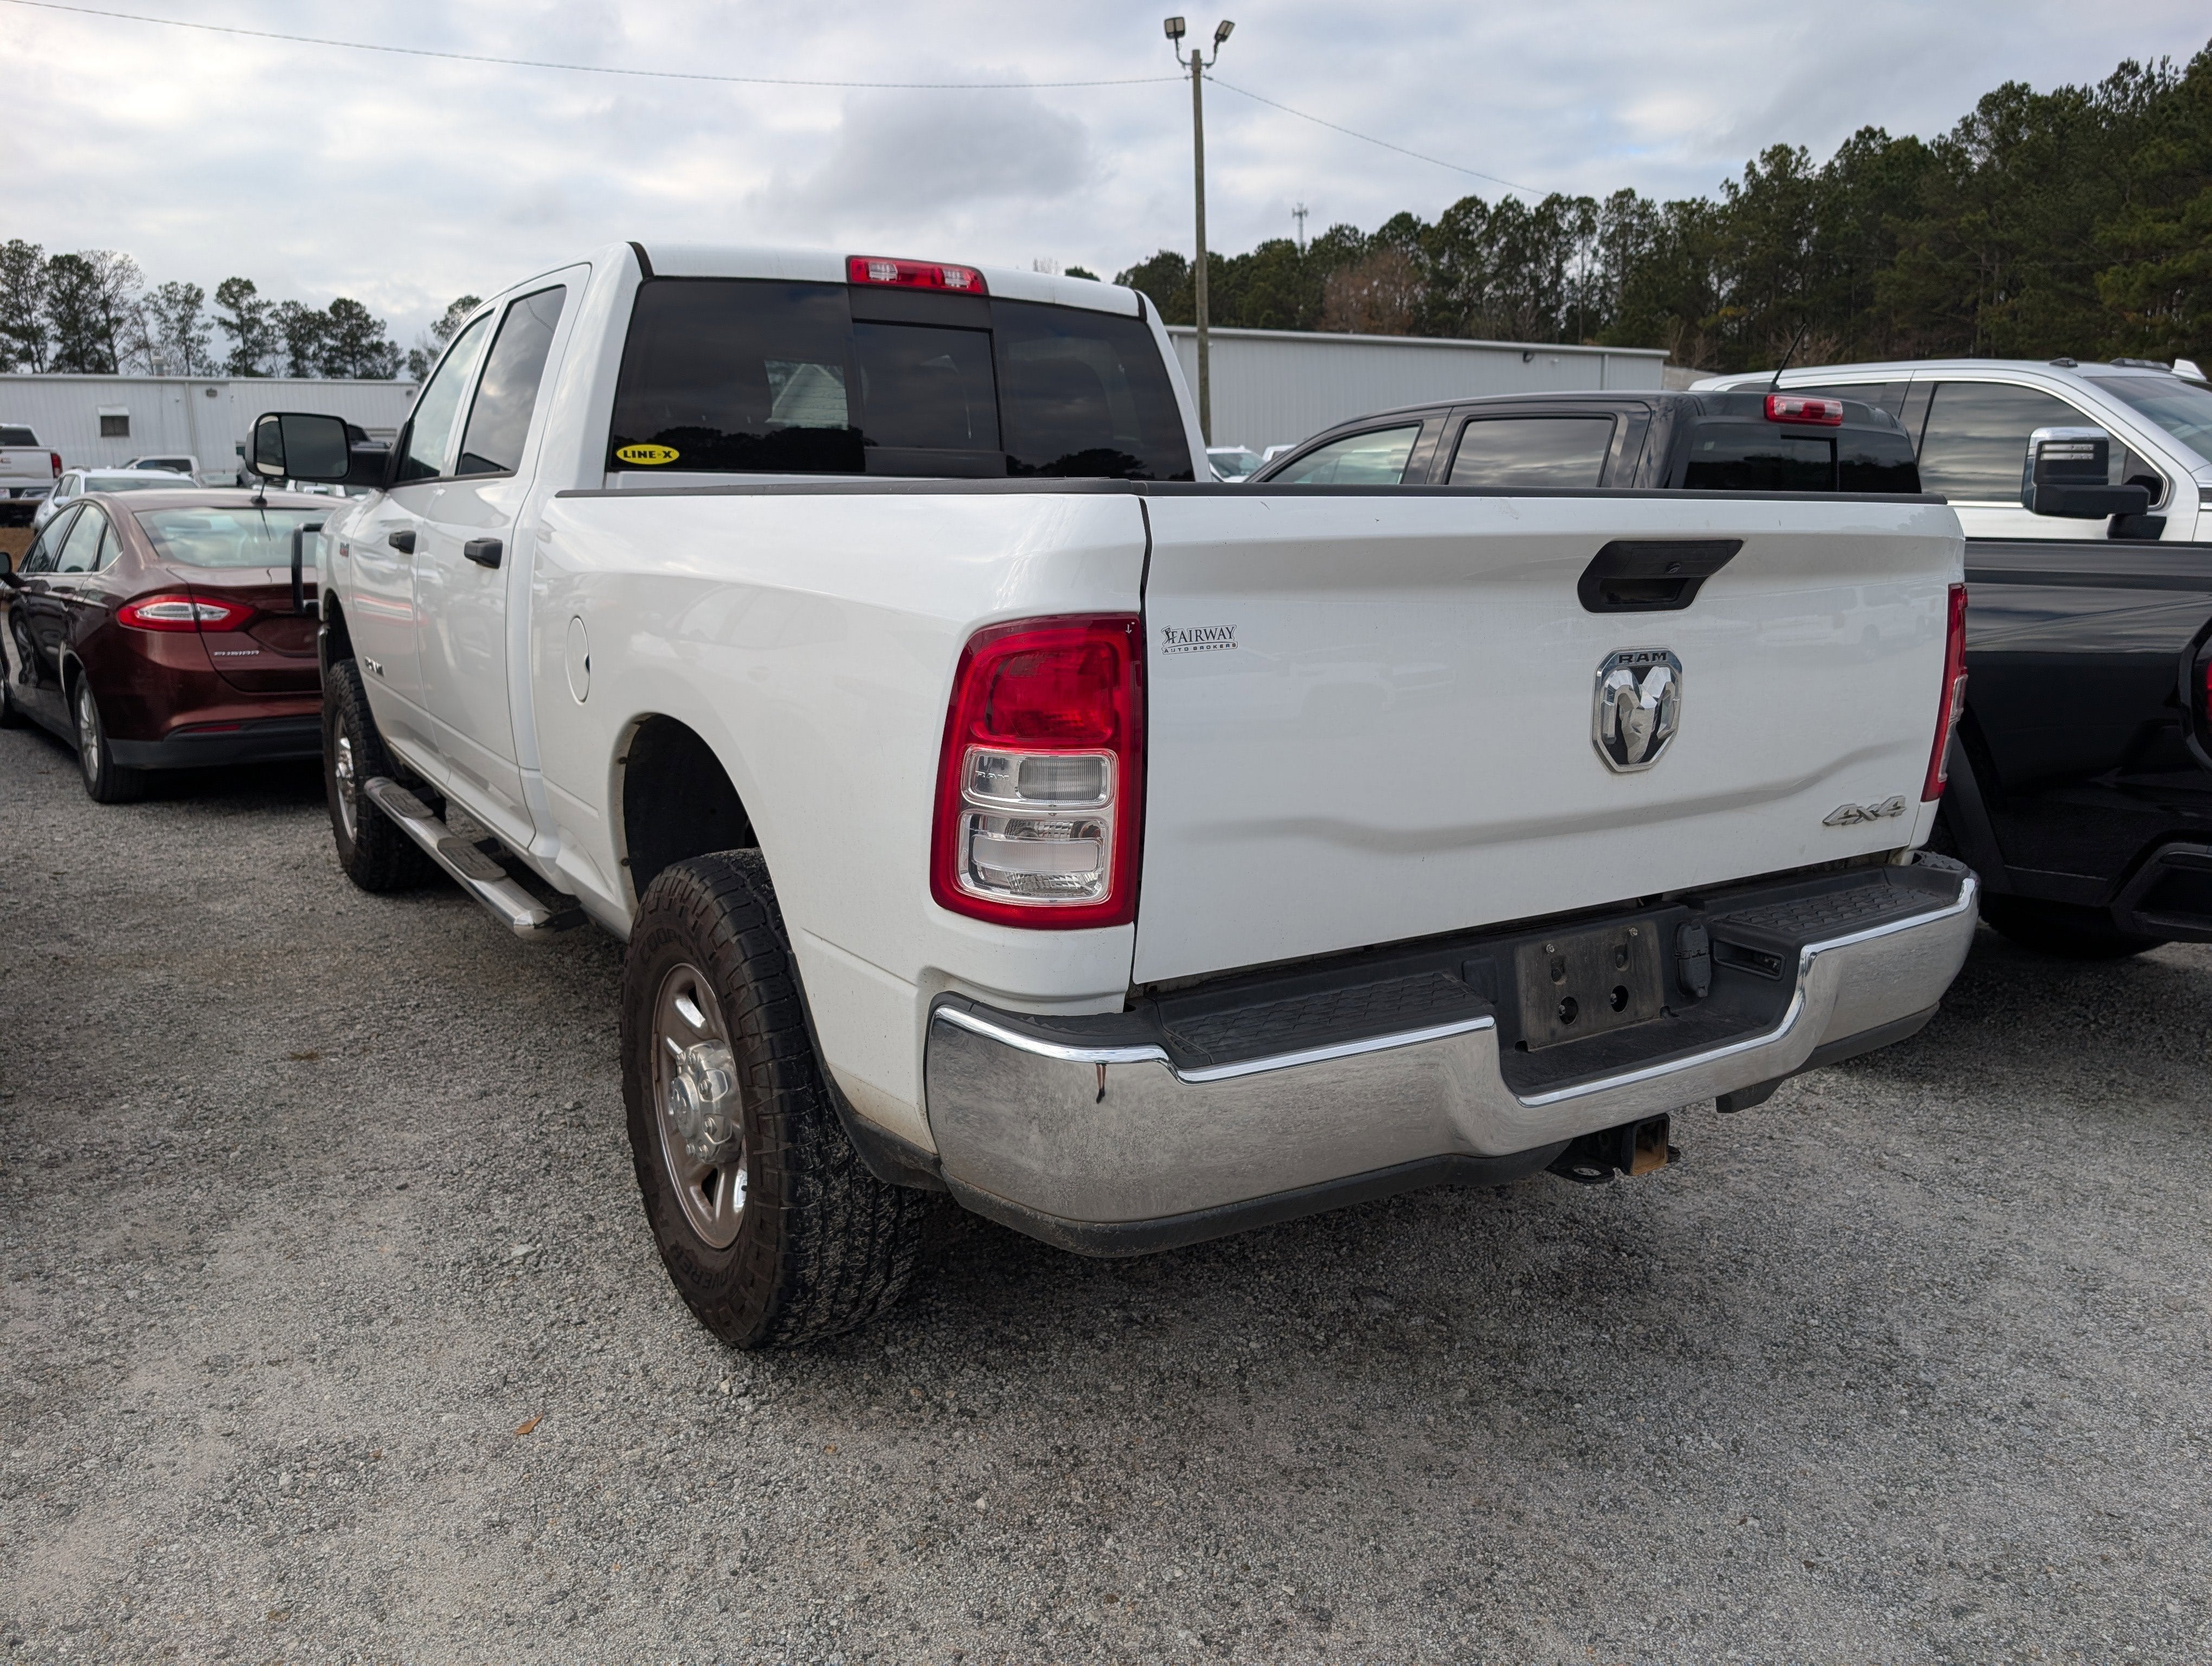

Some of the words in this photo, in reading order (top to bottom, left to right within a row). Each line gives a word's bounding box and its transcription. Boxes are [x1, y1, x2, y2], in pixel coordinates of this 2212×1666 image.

[623, 450, 672, 459] LINE-X
[1170, 626, 1235, 644] FAIRWAY
[1618, 652, 1668, 664] RAM
